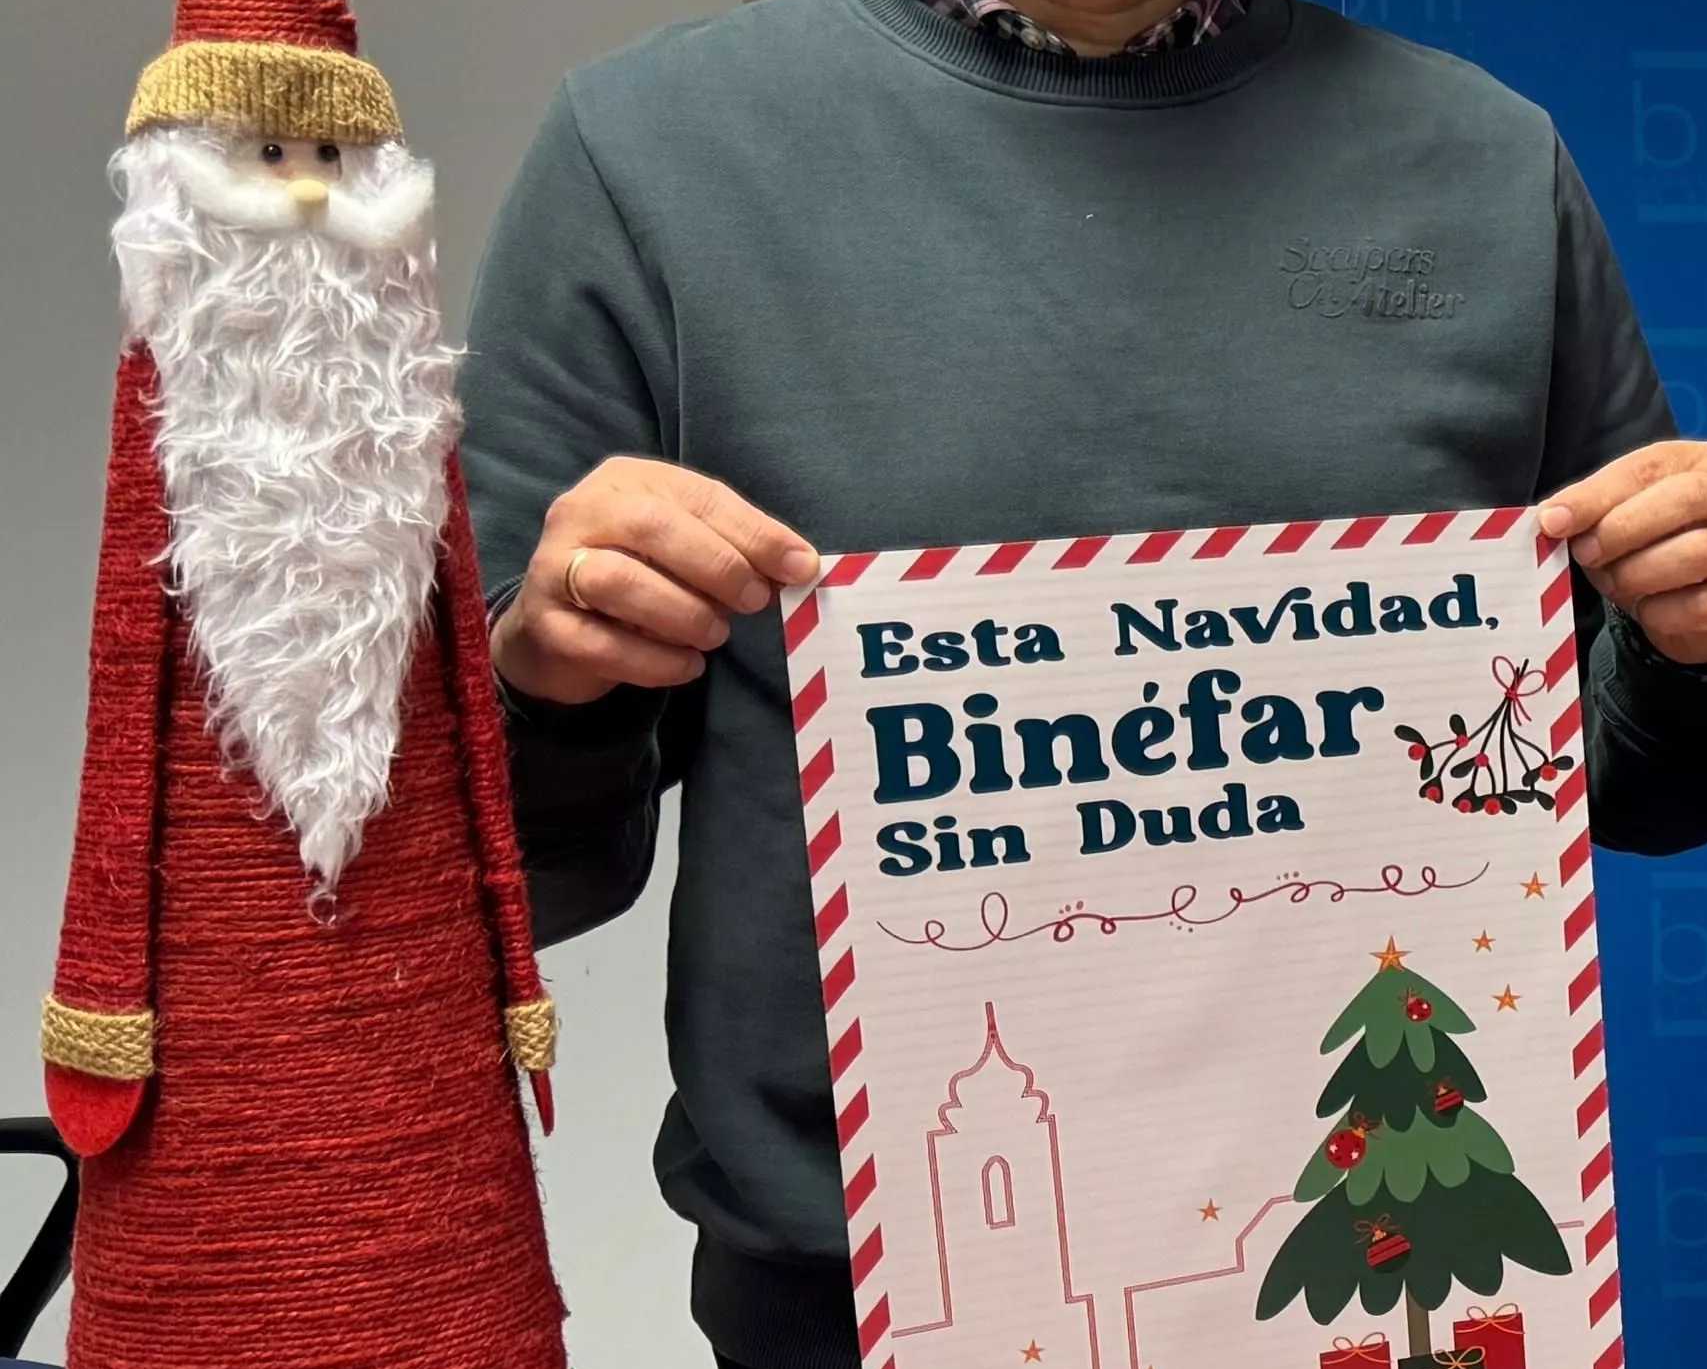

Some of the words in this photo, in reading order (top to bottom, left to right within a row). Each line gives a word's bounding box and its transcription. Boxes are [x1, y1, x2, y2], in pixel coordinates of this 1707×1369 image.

[856, 619, 1064, 677] Esta
[1110, 574, 1498, 655] Navidad,
[866, 669, 1384, 804] Binéfar
[876, 815, 1030, 875] Sin
[1076, 785, 1304, 854] Duda
